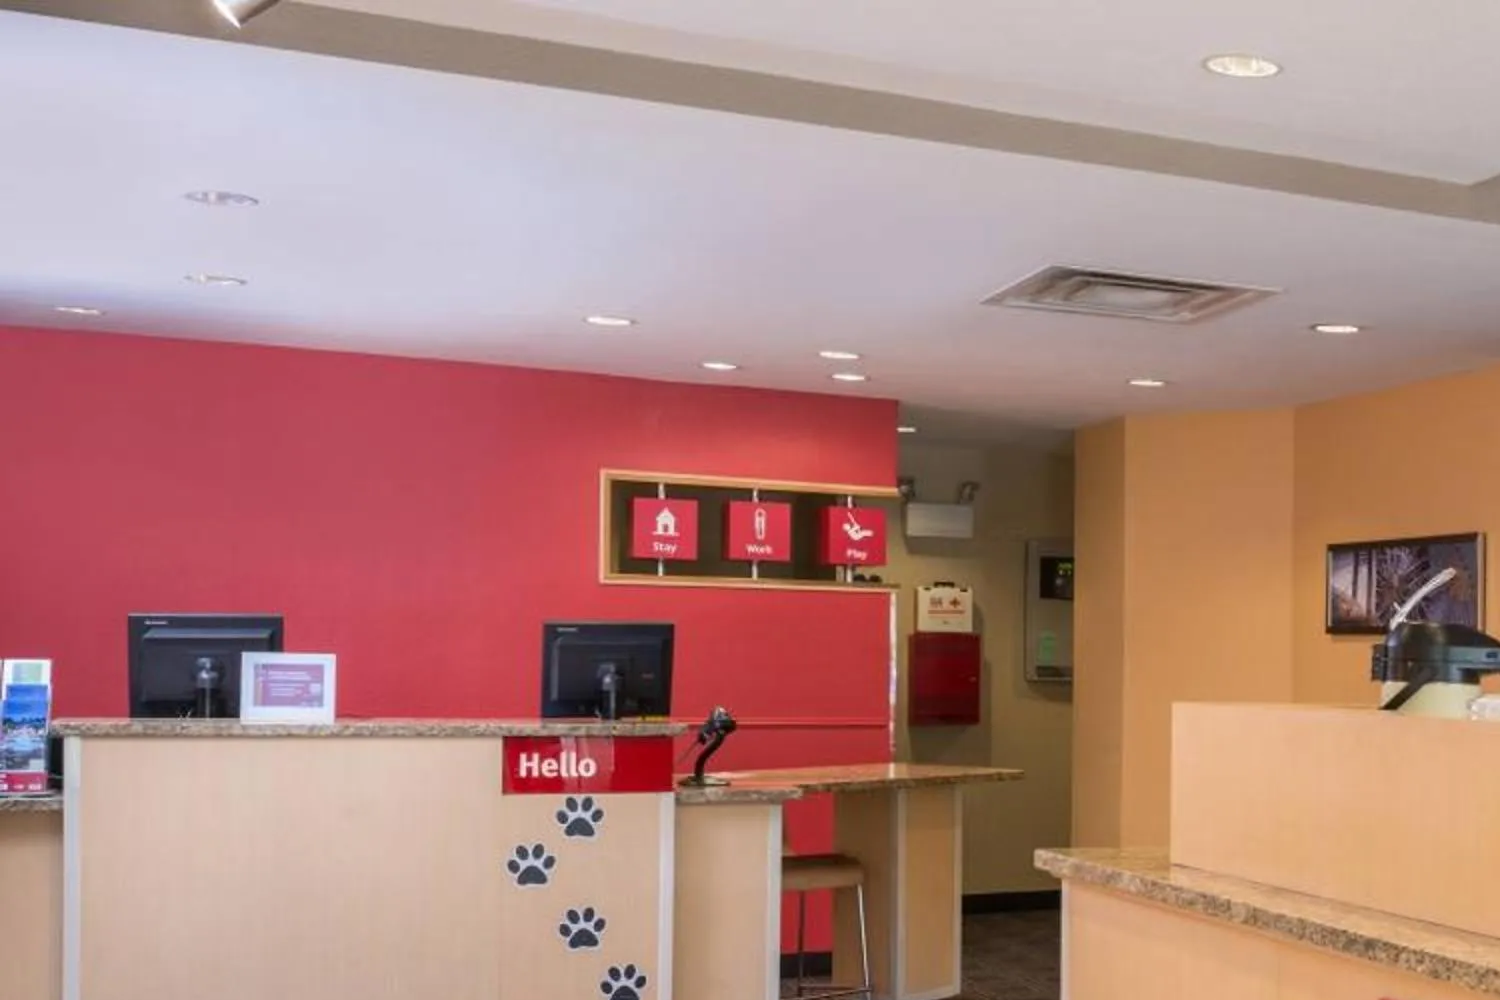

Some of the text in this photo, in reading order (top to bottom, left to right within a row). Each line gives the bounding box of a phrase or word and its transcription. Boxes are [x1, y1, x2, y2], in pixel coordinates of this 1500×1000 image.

[653, 541, 677, 554] Stay
[846, 548, 867, 561] Play
[519, 751, 598, 778] Hello
